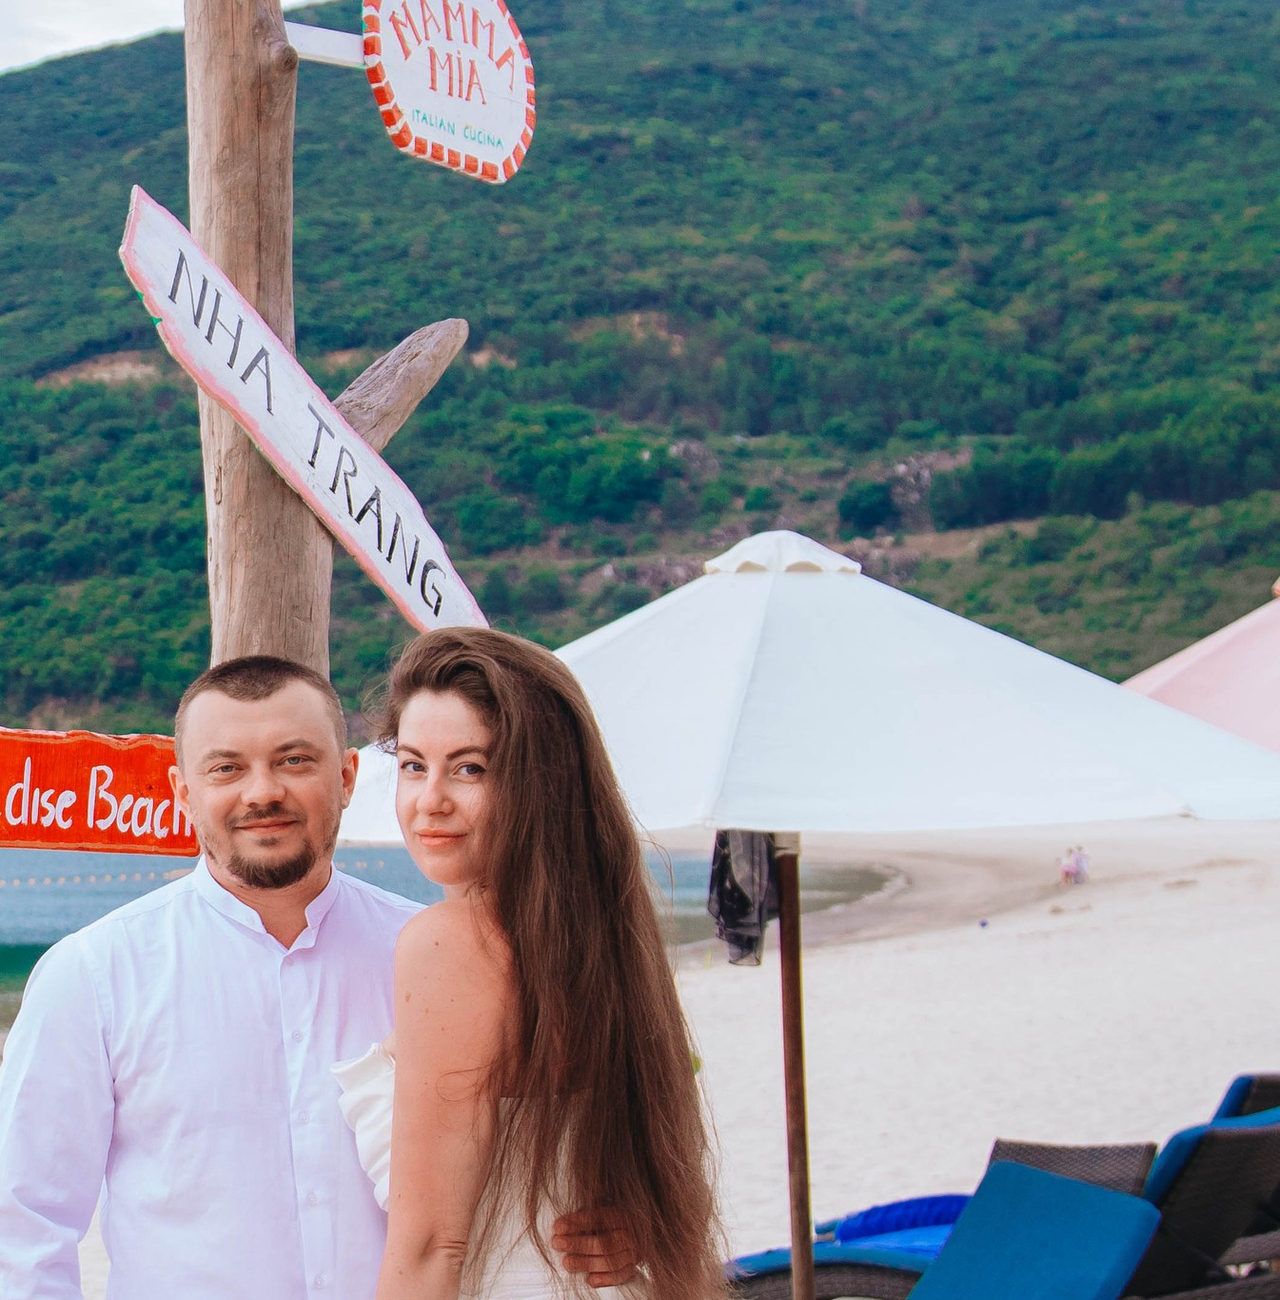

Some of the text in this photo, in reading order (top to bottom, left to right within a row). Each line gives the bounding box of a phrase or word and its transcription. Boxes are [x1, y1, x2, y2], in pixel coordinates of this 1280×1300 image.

[411, 109, 504, 150] ITALIAN CUCINA
[168, 248, 447, 617] NHA TRANG
